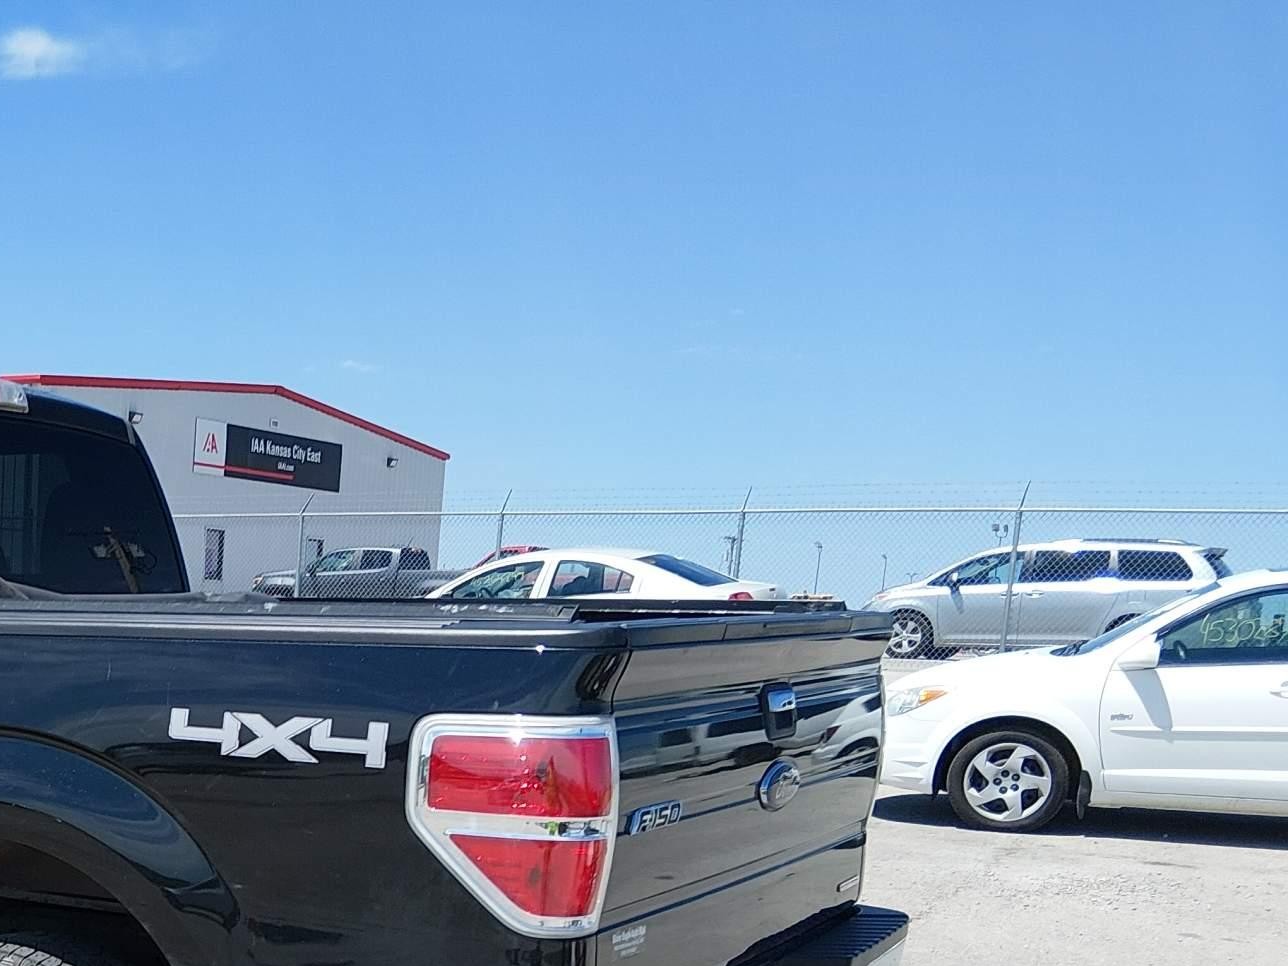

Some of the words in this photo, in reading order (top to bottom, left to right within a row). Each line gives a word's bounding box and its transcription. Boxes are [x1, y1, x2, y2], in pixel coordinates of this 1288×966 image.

[251, 437, 265, 454] IAA
[266, 440, 291, 458] Kansas
[292, 444, 306, 464] City
[306, 447, 321, 464] East
